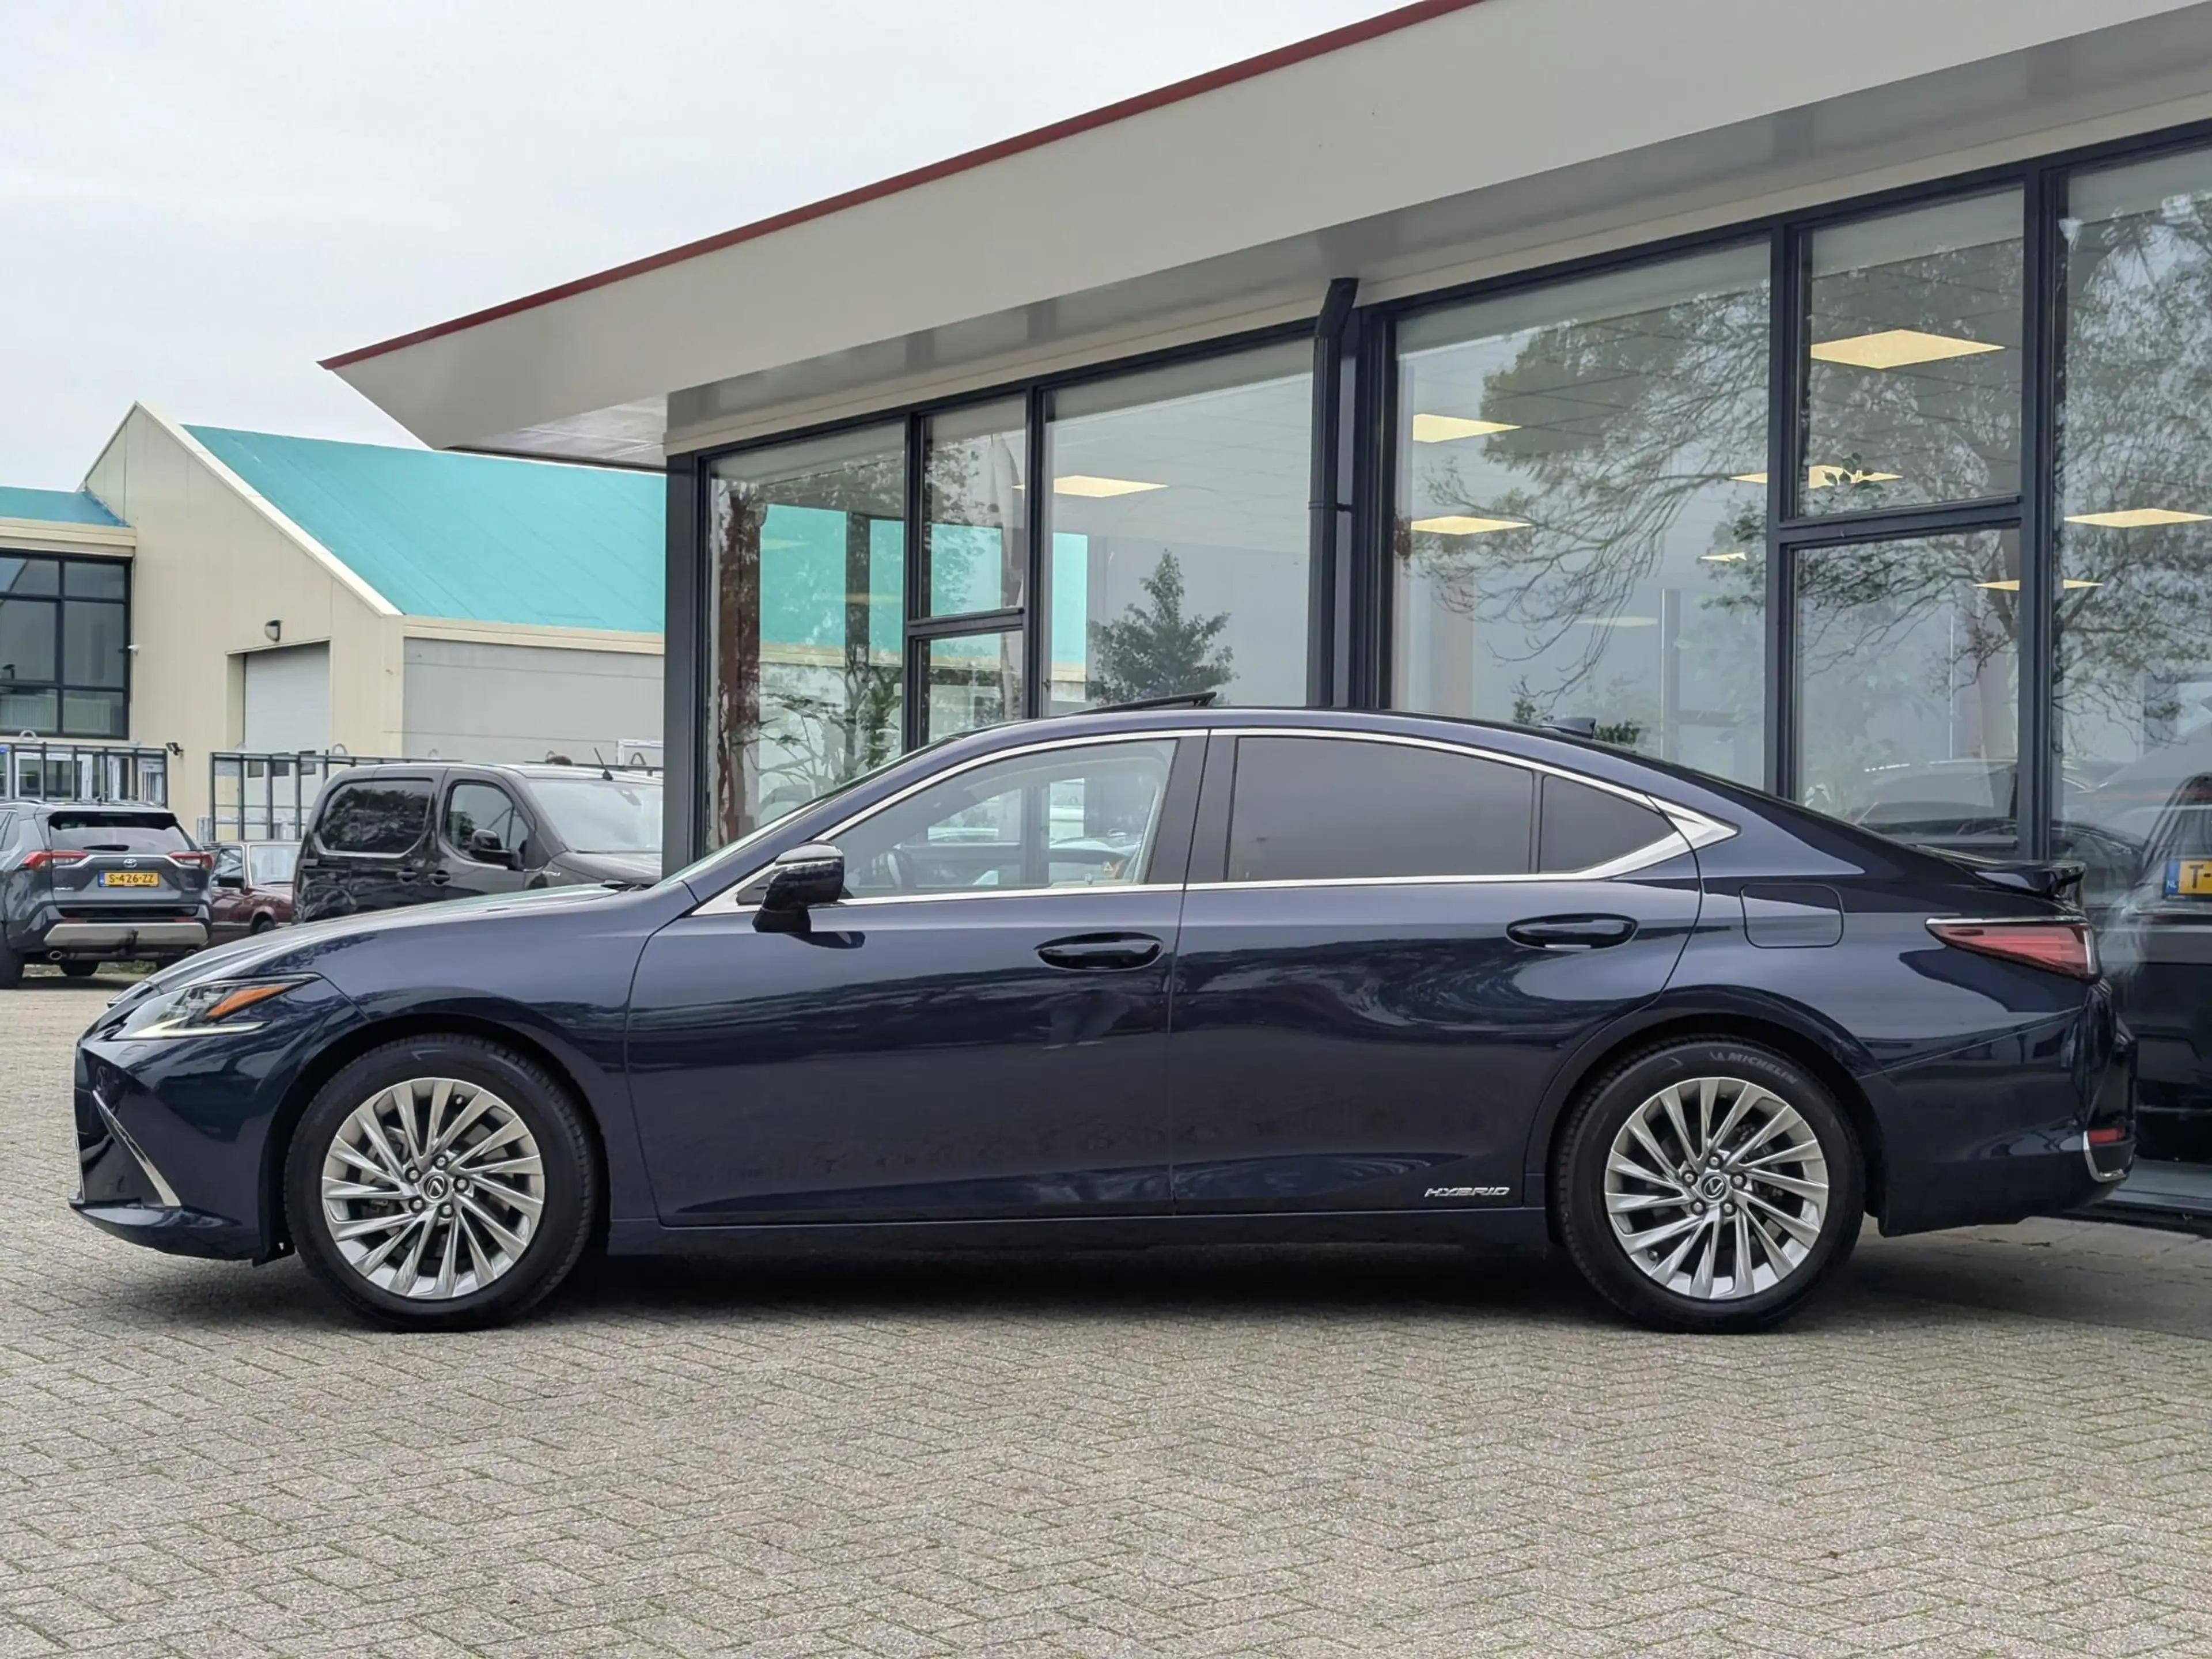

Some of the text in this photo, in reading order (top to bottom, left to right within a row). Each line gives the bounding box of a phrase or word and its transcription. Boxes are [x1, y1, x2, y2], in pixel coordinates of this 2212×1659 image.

[109, 874, 154, 883] S-426-ZZ
[1729, 1052, 1798, 1084] MICHELIN
[1424, 1187, 1510, 1198] HYBRID
